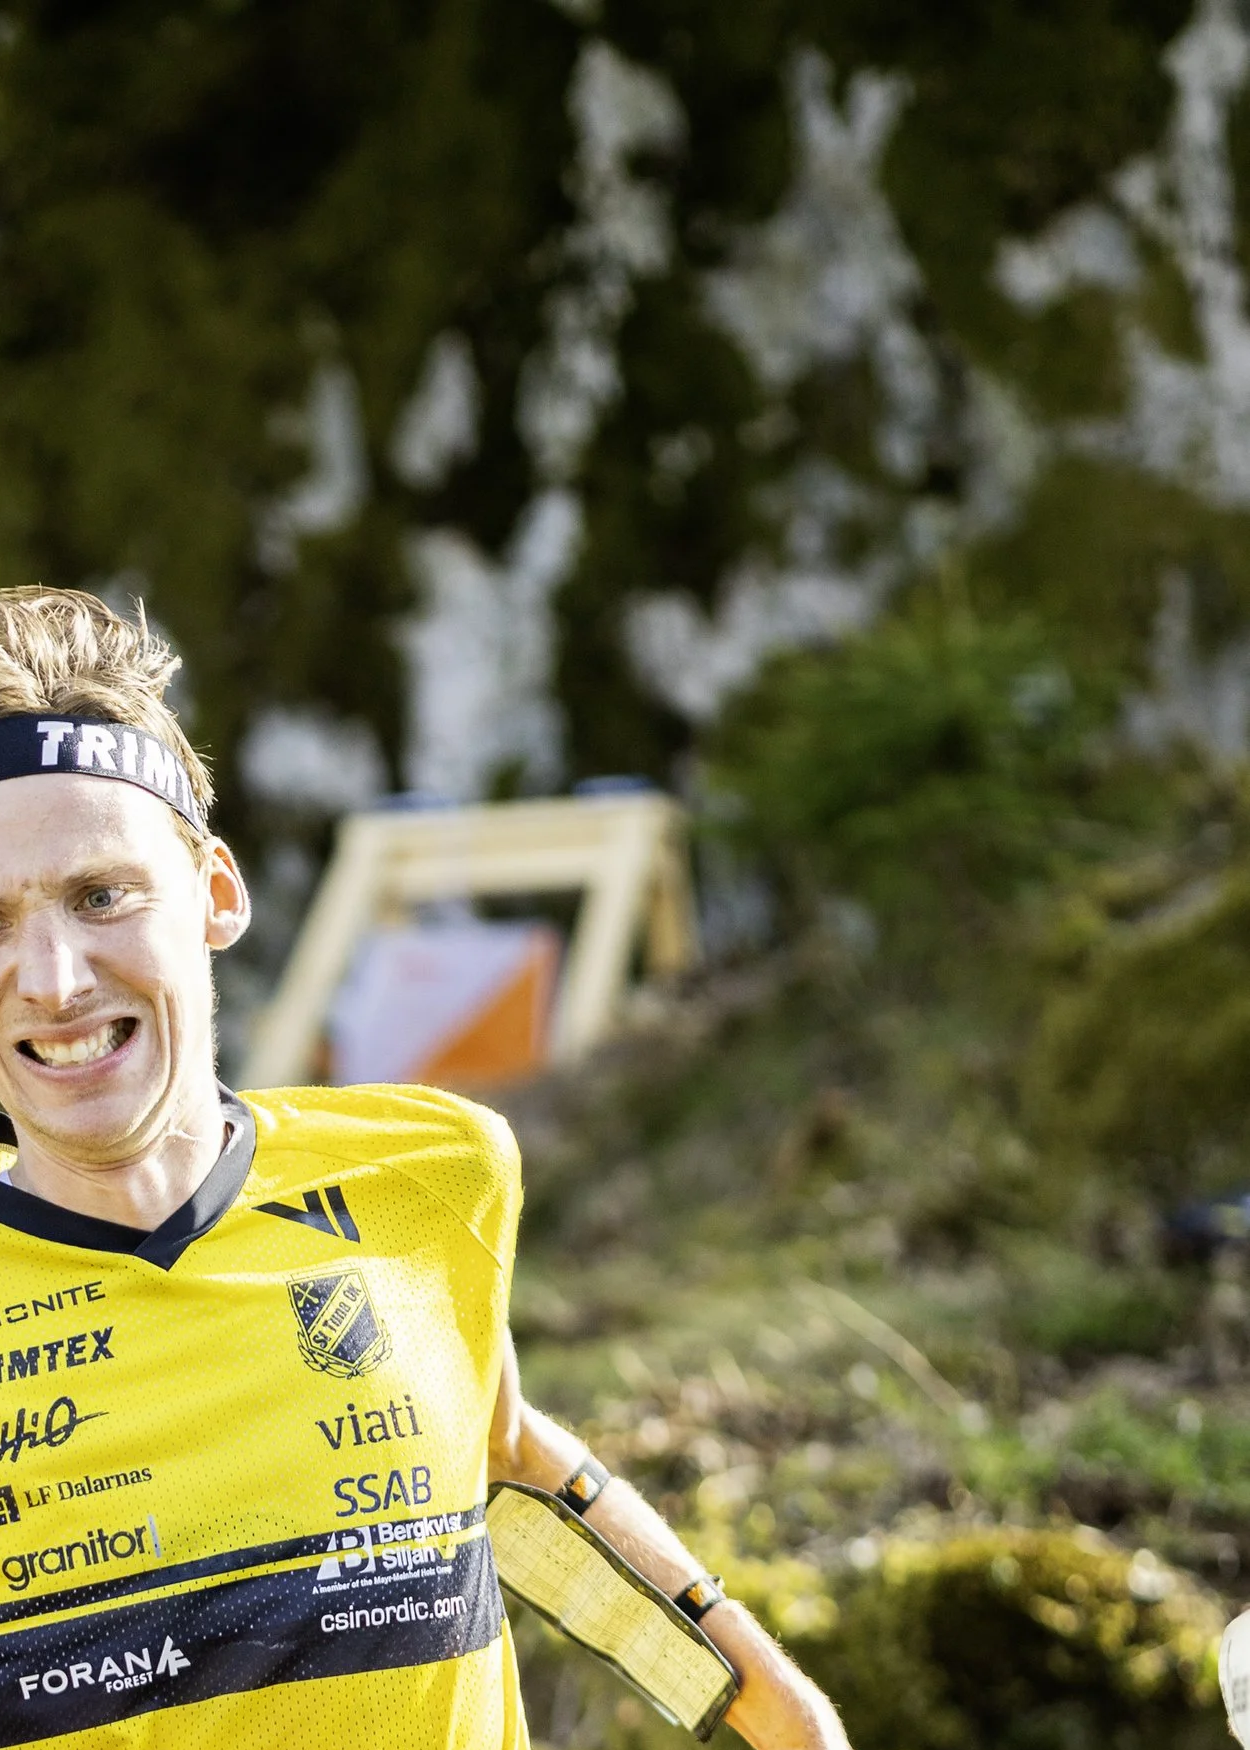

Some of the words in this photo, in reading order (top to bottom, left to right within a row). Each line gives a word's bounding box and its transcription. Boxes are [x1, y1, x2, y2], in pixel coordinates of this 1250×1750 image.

[315, 1394, 423, 1450] viati
[23, 1485, 54, 1508] LF
[59, 1466, 153, 1502] Dalarnas
[333, 1464, 433, 1517] SSAB
[377, 1512, 462, 1543] Bergkvist
[1, 1525, 148, 1592] granitor
[382, 1544, 436, 1570] Siljan
[319, 1582, 350, 1593] member
[320, 1595, 468, 1632] csinordic.com
[19, 1647, 152, 1700] FORAN
[105, 1671, 153, 1694] FOREST
